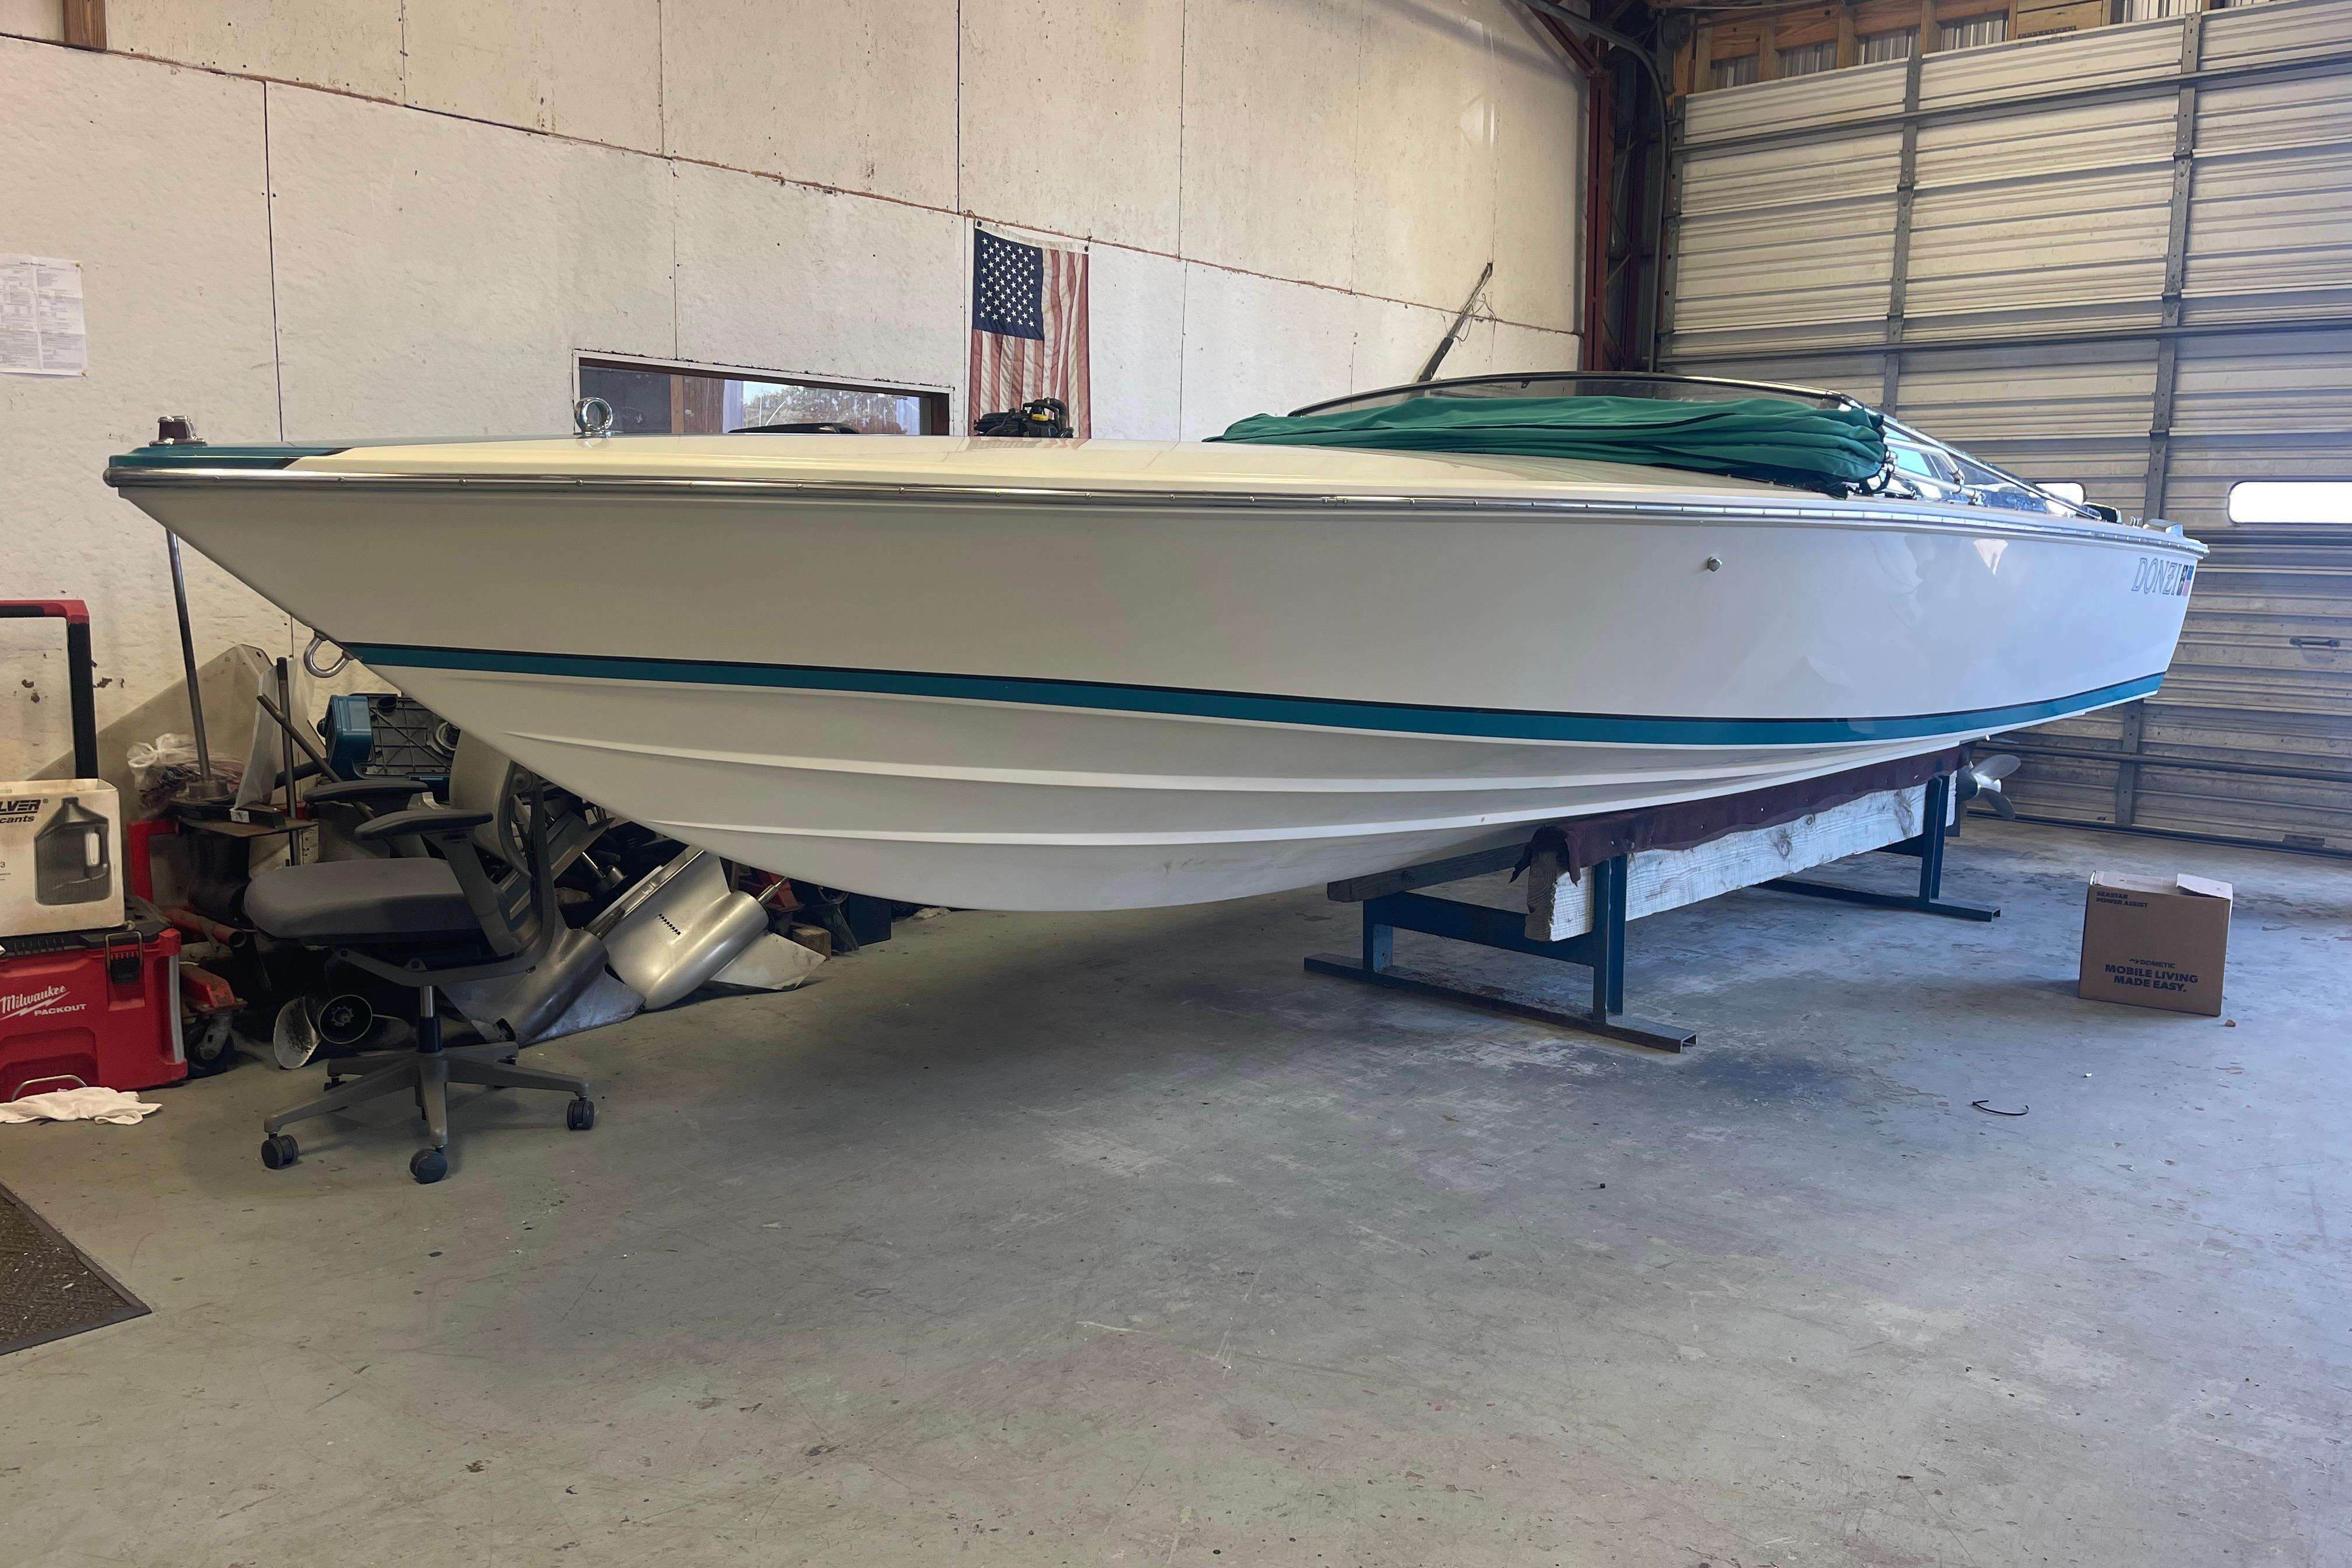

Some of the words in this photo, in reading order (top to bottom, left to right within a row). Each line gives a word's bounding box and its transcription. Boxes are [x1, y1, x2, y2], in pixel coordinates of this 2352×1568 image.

[2132, 558, 2182, 595] DONZI
[2140, 959, 2176, 969] DOMETIC
[2105, 964, 2152, 978] MOBILE
[2155, 970, 2199, 984] LIVING
[2113, 975, 2151, 988] MADE
[2152, 980, 2187, 992] EASY.
[0, 985, 67, 1014] Milwaukee
[34, 1003, 88, 1016] PACKOUT
